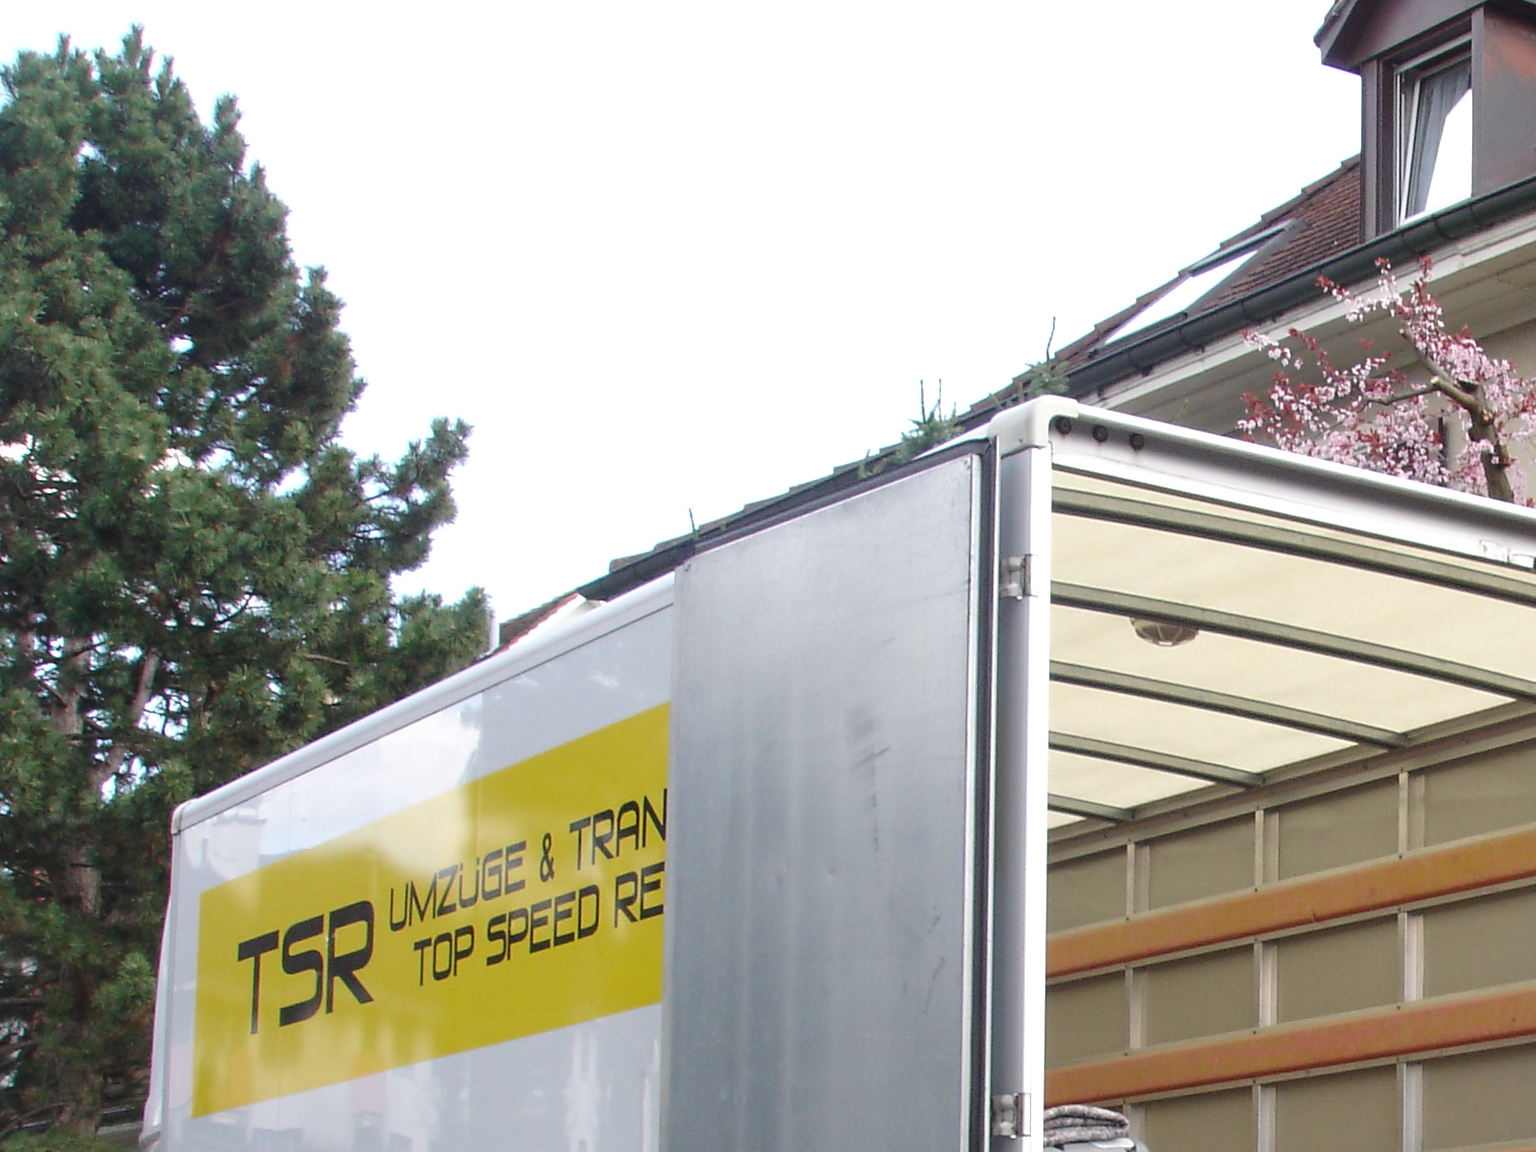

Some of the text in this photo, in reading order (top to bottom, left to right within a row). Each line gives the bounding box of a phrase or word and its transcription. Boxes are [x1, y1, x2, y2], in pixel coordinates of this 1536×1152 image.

[389, 788, 667, 932] UMZÜGE & TRAN
[413, 861, 666, 987] TOP SPEED RE
[237, 899, 375, 1035] TSR
